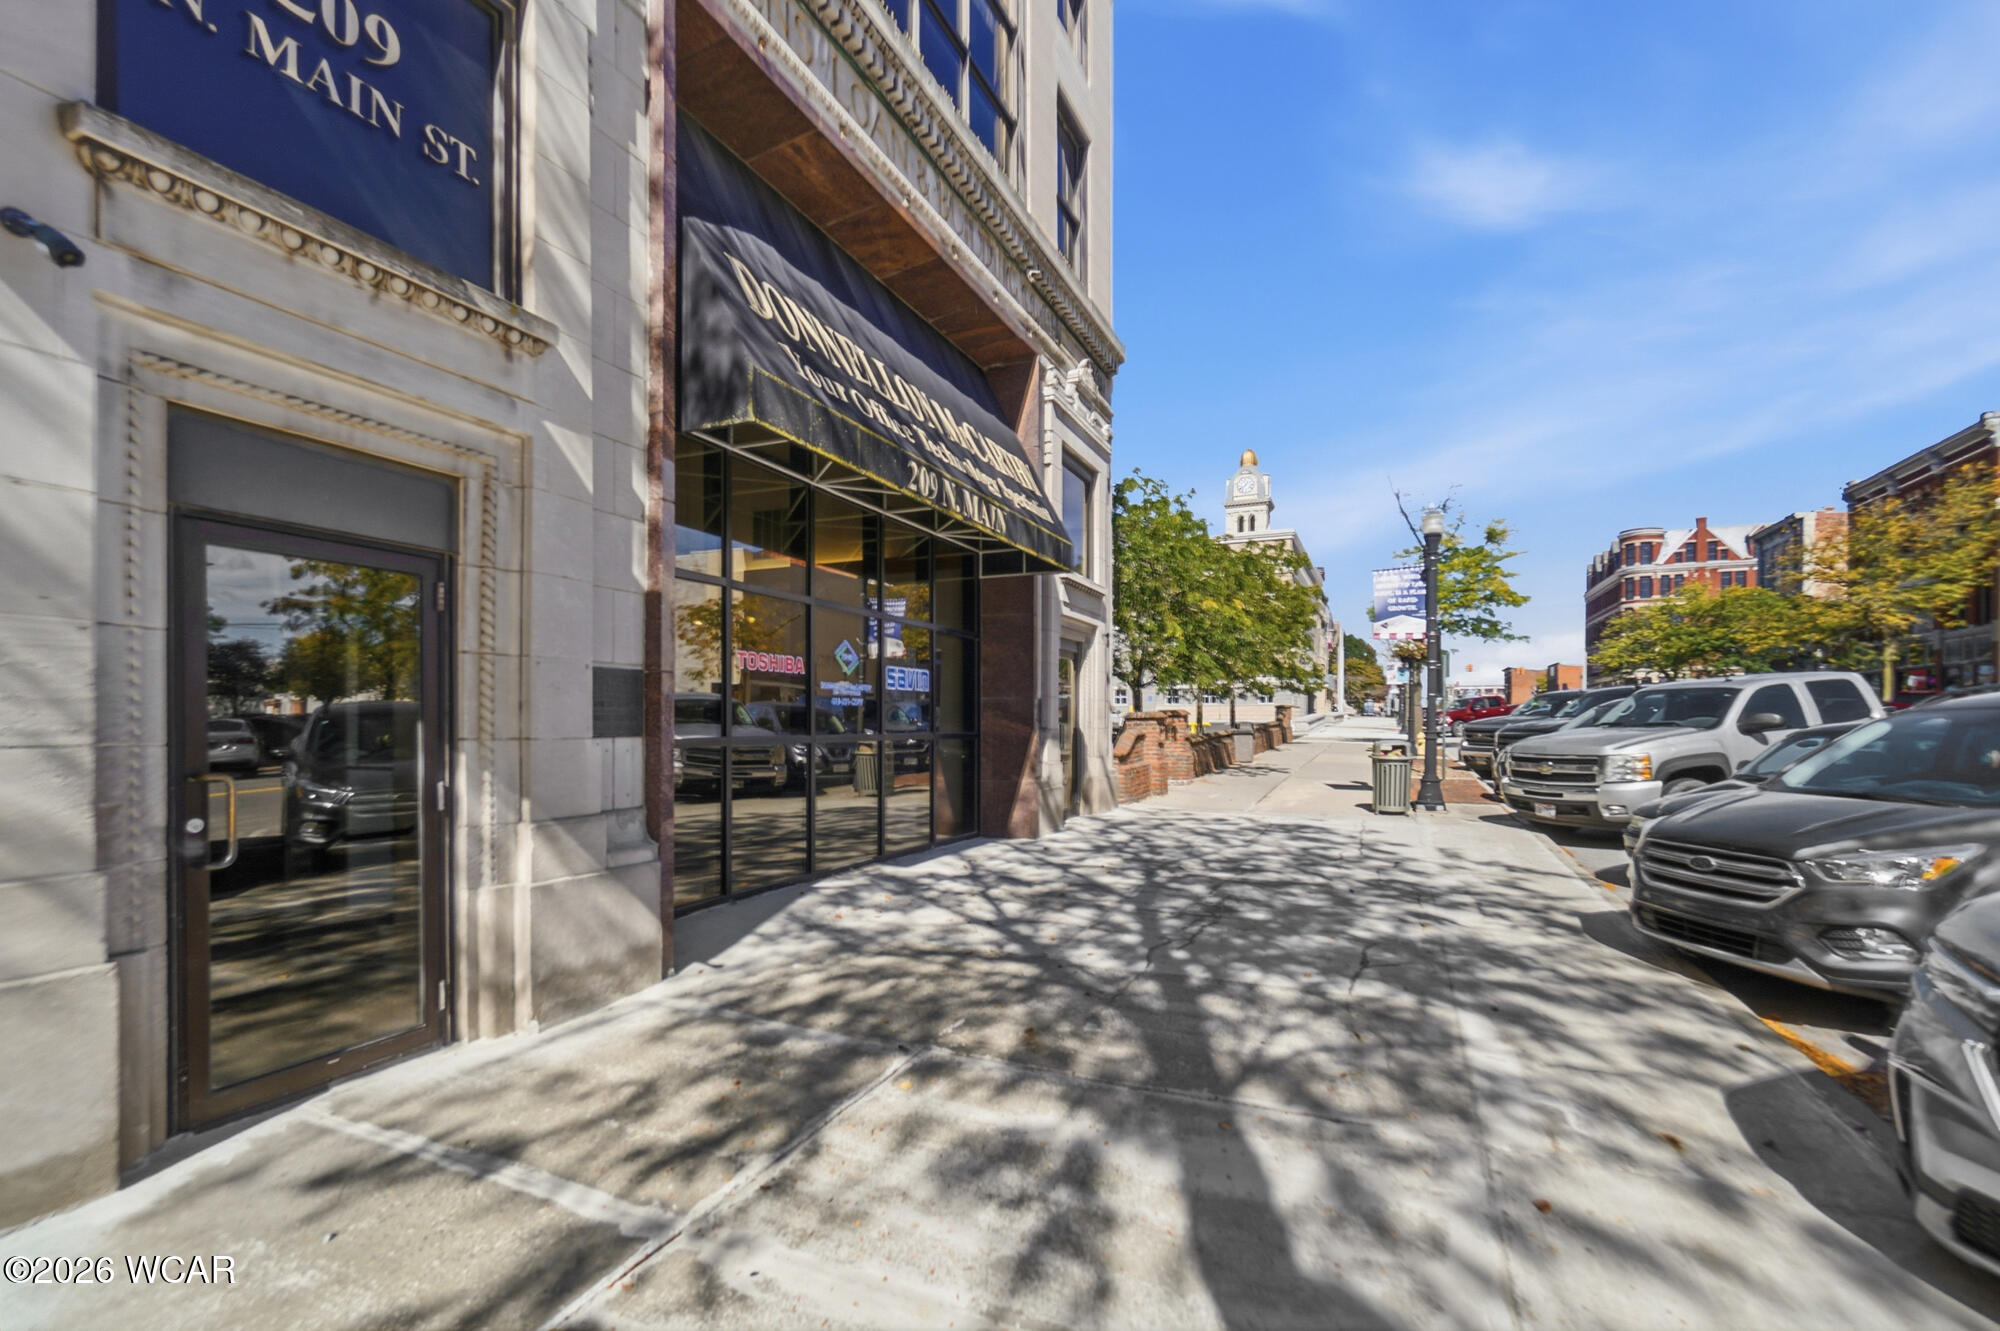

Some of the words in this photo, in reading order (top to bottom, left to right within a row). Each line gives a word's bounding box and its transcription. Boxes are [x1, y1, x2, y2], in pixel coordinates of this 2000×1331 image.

[245, 10, 405, 138] MAIN
[423, 123, 480, 187] ST.
[723, 251, 944, 435] DONNELLON
[777, 341, 849, 403] Your
[849, 388, 916, 443] Office
[907, 460, 938, 499] 209
[942, 478, 960, 513] N.
[962, 488, 1007, 536] MAIN
[736, 649, 806, 675] TOSHIBA
